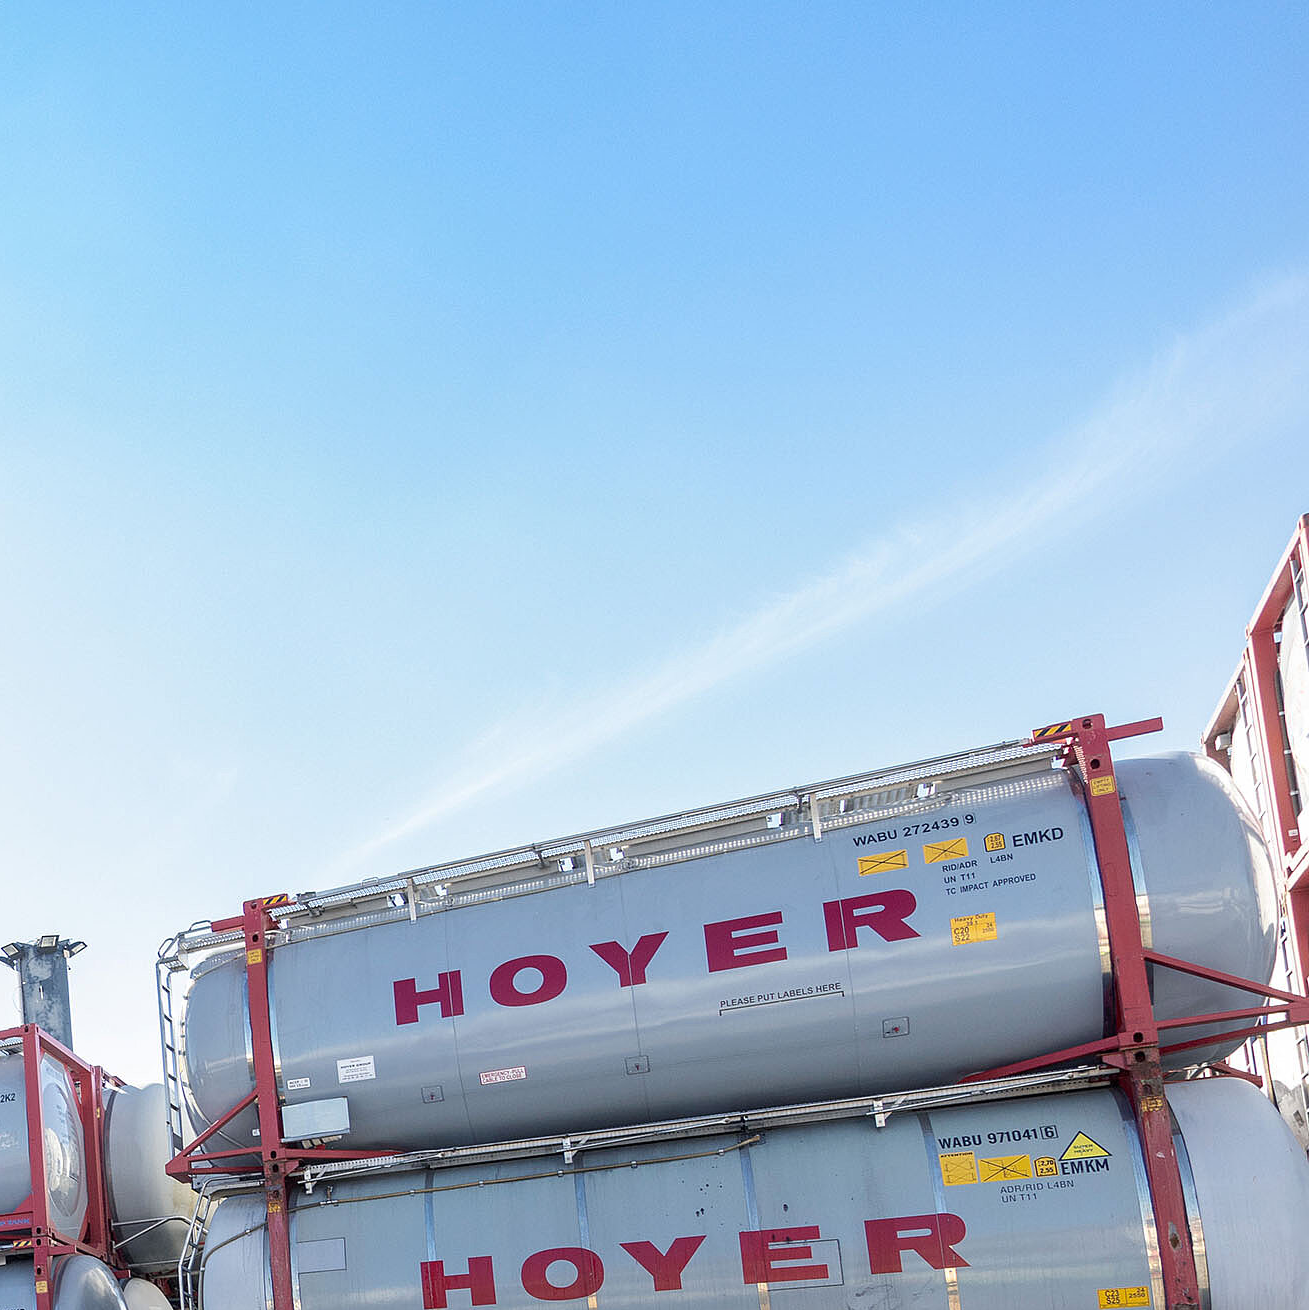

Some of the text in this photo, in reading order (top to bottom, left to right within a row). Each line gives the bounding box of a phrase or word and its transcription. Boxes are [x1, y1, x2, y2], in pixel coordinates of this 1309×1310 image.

[852, 814, 974, 847] WABU 272439 9
[1012, 827, 1064, 847] EMKD
[942, 853, 1014, 872] RID/ADR L4BN
[944, 873, 976, 884] UN T11
[945, 873, 1037, 896] TC IMPACT APPROVED
[394, 888, 921, 1026] HOYER
[720, 982, 841, 1008] PLEASE PUT LABELS HERE
[937, 1126, 1054, 1149] WABU 971041 6
[1061, 1158, 1110, 1175] EMKM
[1000, 1180, 1074, 1194] ADR/RID L4BN
[1001, 1193, 1037, 1203] UN T11
[422, 1212, 970, 1310] HOYER
